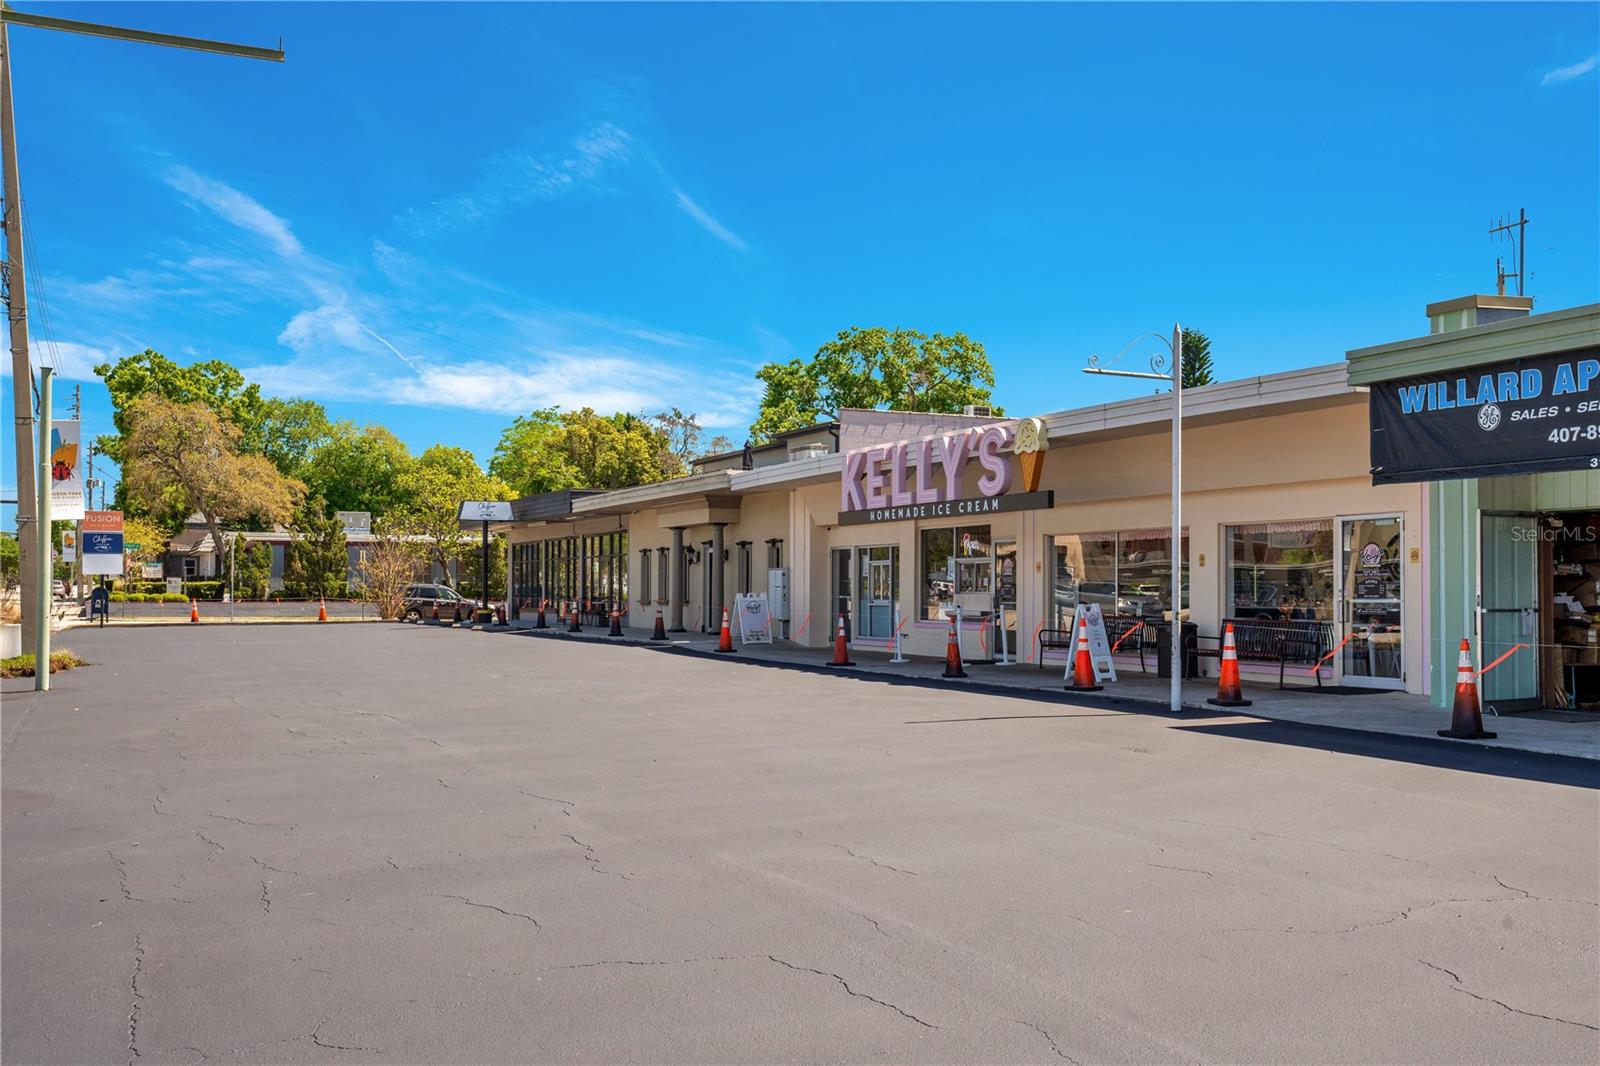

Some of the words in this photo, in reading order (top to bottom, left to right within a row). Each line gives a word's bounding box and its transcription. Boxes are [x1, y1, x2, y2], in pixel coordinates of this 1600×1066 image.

[1398, 368, 1544, 414] WILLARD
[1552, 359, 1600, 396] AP
[1510, 406, 1559, 421] SALES
[841, 427, 1012, 512] KELLY'S
[84, 514, 121, 523] FUSION
[870, 505, 926, 521] HOMEMADE
[932, 503, 950, 515] ICE
[959, 499, 999, 513] CREAM
